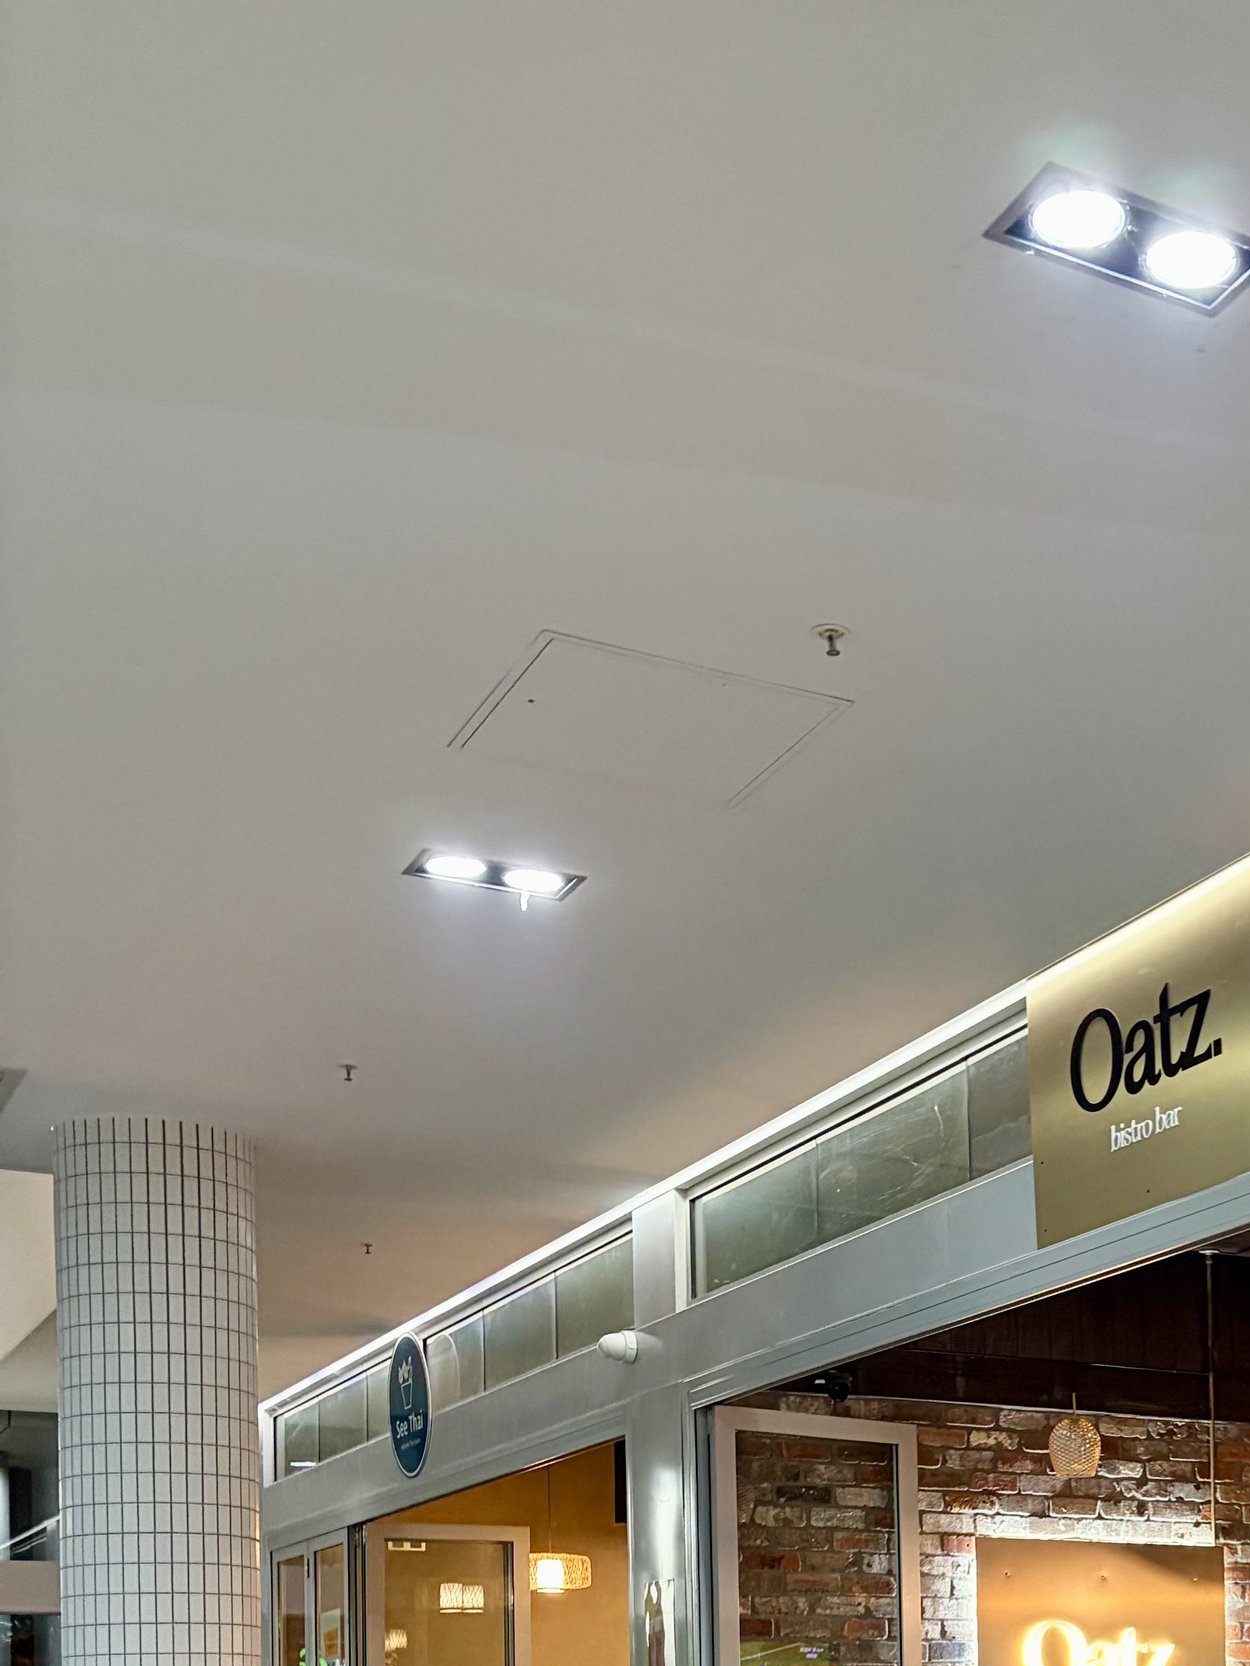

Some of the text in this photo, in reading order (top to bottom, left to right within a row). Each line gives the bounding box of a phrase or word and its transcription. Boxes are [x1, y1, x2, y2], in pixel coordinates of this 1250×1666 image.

[1070, 982, 1222, 1112] Oatz.
[1110, 1106, 1182, 1152] bistro bar
[396, 1409, 424, 1438] See Thai
